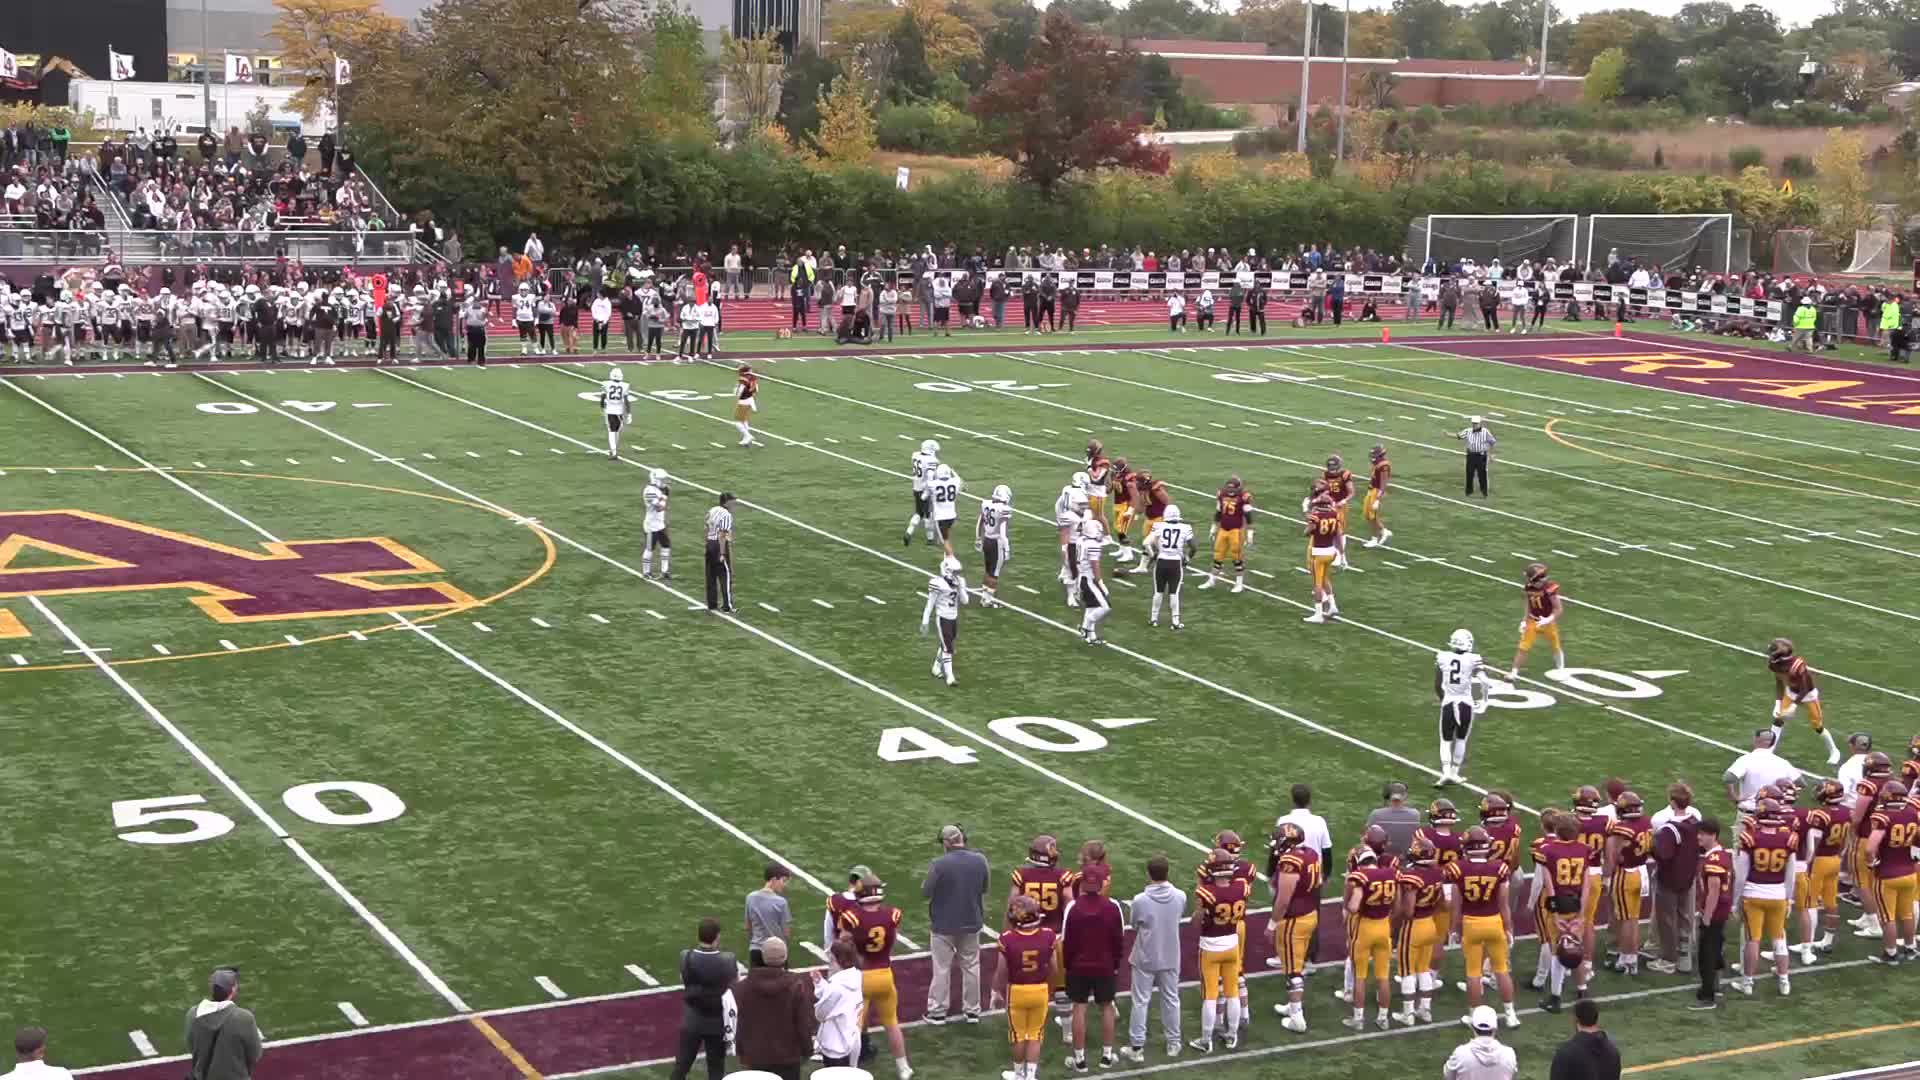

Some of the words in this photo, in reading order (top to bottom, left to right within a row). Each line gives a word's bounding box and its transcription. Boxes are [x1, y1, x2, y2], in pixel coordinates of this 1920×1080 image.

[608, 385, 623, 401] 23
[935, 485, 957, 502] 28
[1222, 501, 1237, 515] 75
[1162, 528, 1181, 549] 97
[1320, 518, 1337, 535] 87
[948, 592, 957, 608] 3
[1450, 659, 1461, 685] 2
[877, 716, 1108, 765] 40
[1754, 848, 1787, 873] 96
[1024, 882, 1058, 911] 55
[1365, 879, 1397, 906] 29
[1463, 875, 1498, 903] 57
[864, 926, 886, 953] 3
[1022, 950, 1040, 973] 5
